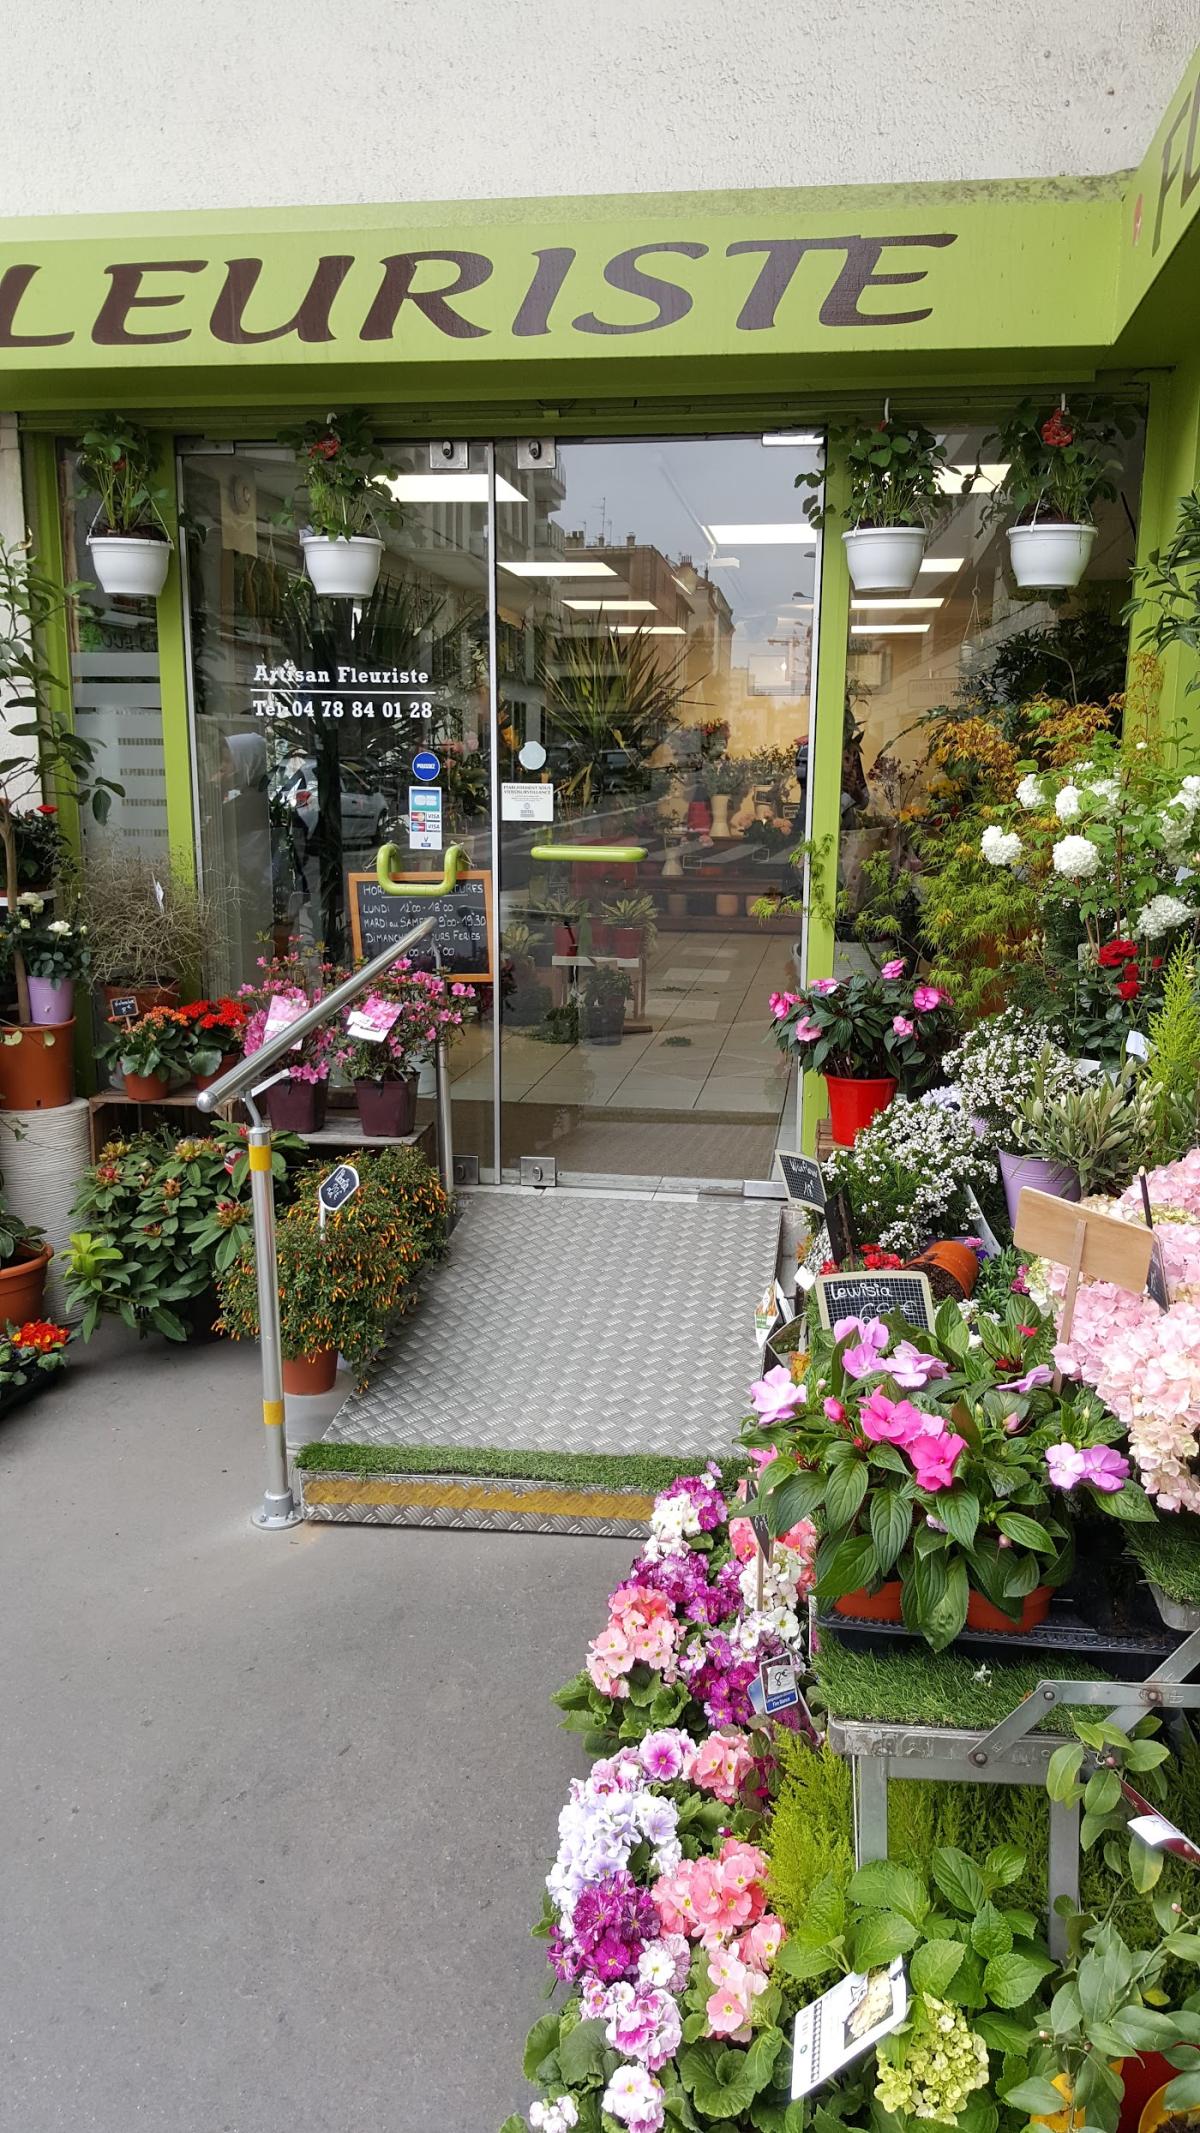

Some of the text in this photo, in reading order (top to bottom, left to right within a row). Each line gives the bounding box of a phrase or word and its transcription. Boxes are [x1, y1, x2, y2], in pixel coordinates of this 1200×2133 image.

[253, 665, 429, 684] Artisan Fleuriste
[292, 701, 314, 718] 04
[322, 701, 344, 718] 78
[352, 702, 375, 718] 84
[382, 702, 403, 719] 01
[409, 702, 432, 719] 28
